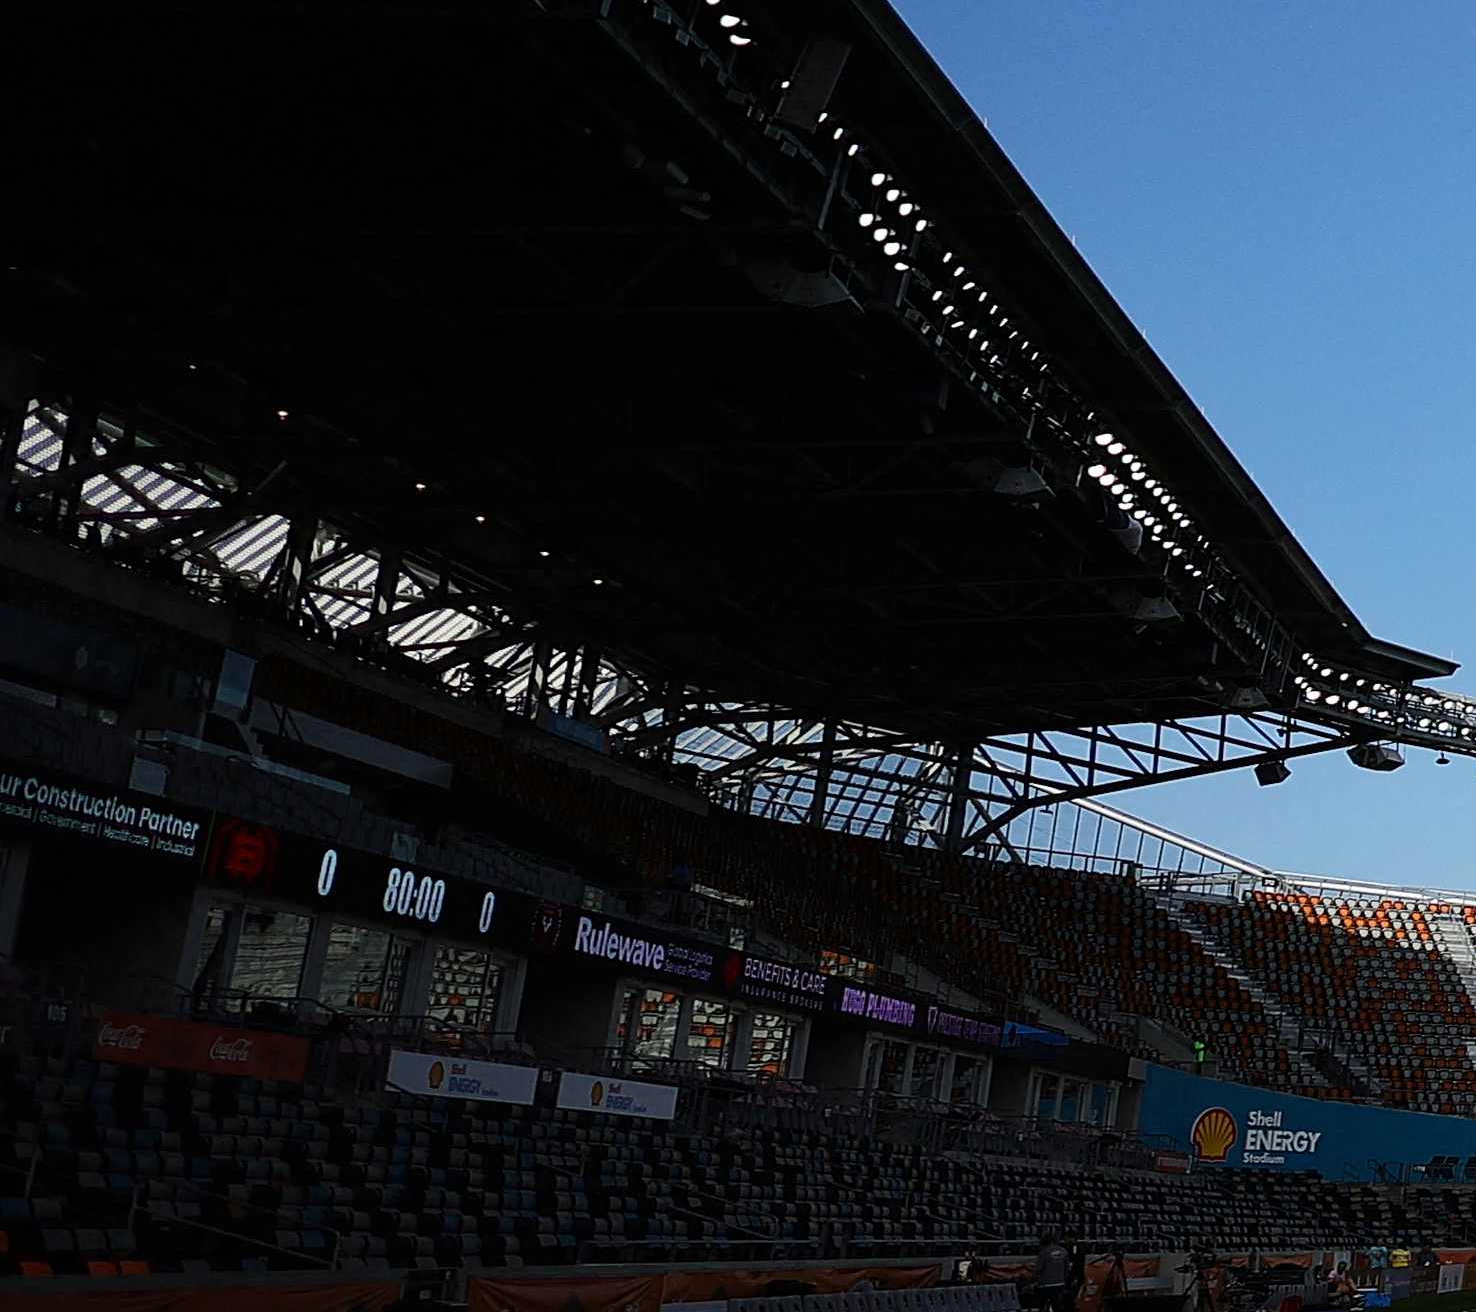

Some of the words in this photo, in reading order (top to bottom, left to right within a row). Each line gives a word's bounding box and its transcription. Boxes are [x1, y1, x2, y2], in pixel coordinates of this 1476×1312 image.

[24, 778, 137, 826] Construction
[138, 807, 200, 840] Partner
[317, 849, 338, 896] 0
[382, 867, 446, 924] 80:00
[478, 890, 496, 934] 0
[574, 915, 665, 971] Rulewave
[743, 957, 792, 986] BENEFITS
[800, 971, 828, 995] CARE
[1247, 1110, 1283, 1128] Shell
[1241, 1152, 1285, 1164] Stadium
[1244, 1129, 1322, 1154] ENERGY
